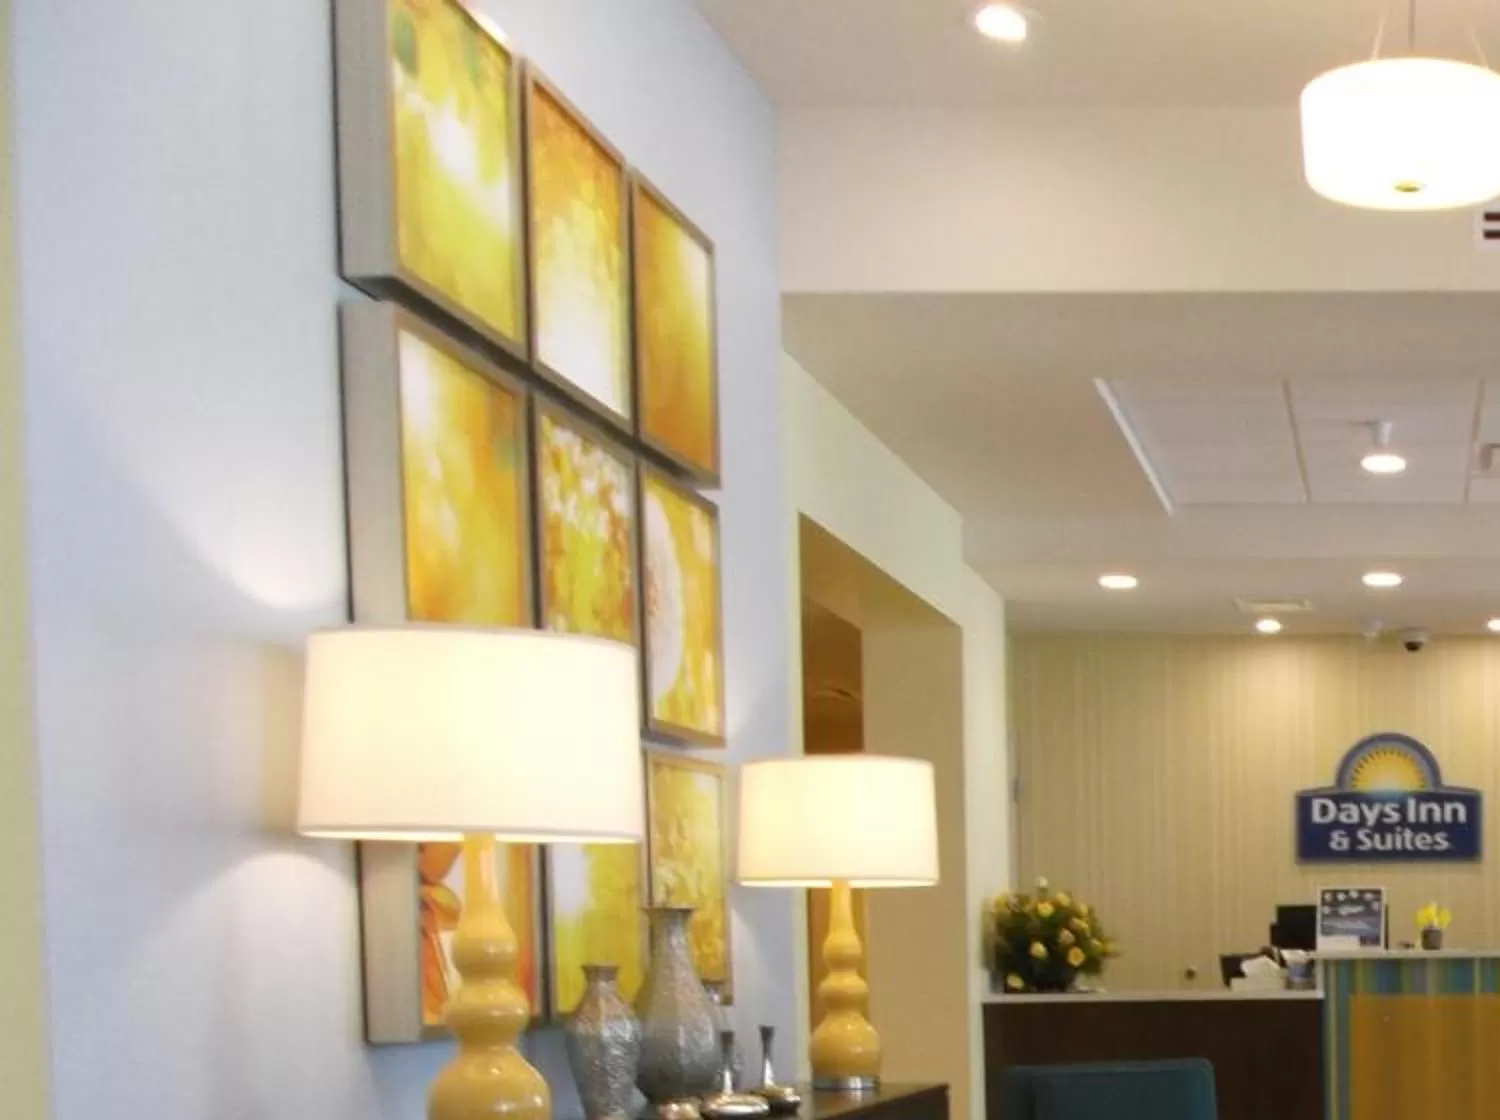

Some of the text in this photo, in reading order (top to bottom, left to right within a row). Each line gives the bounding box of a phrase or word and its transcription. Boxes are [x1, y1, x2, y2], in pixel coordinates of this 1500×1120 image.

[1311, 797, 1467, 826] Days Inn
[1329, 826, 1450, 850] & Suites
